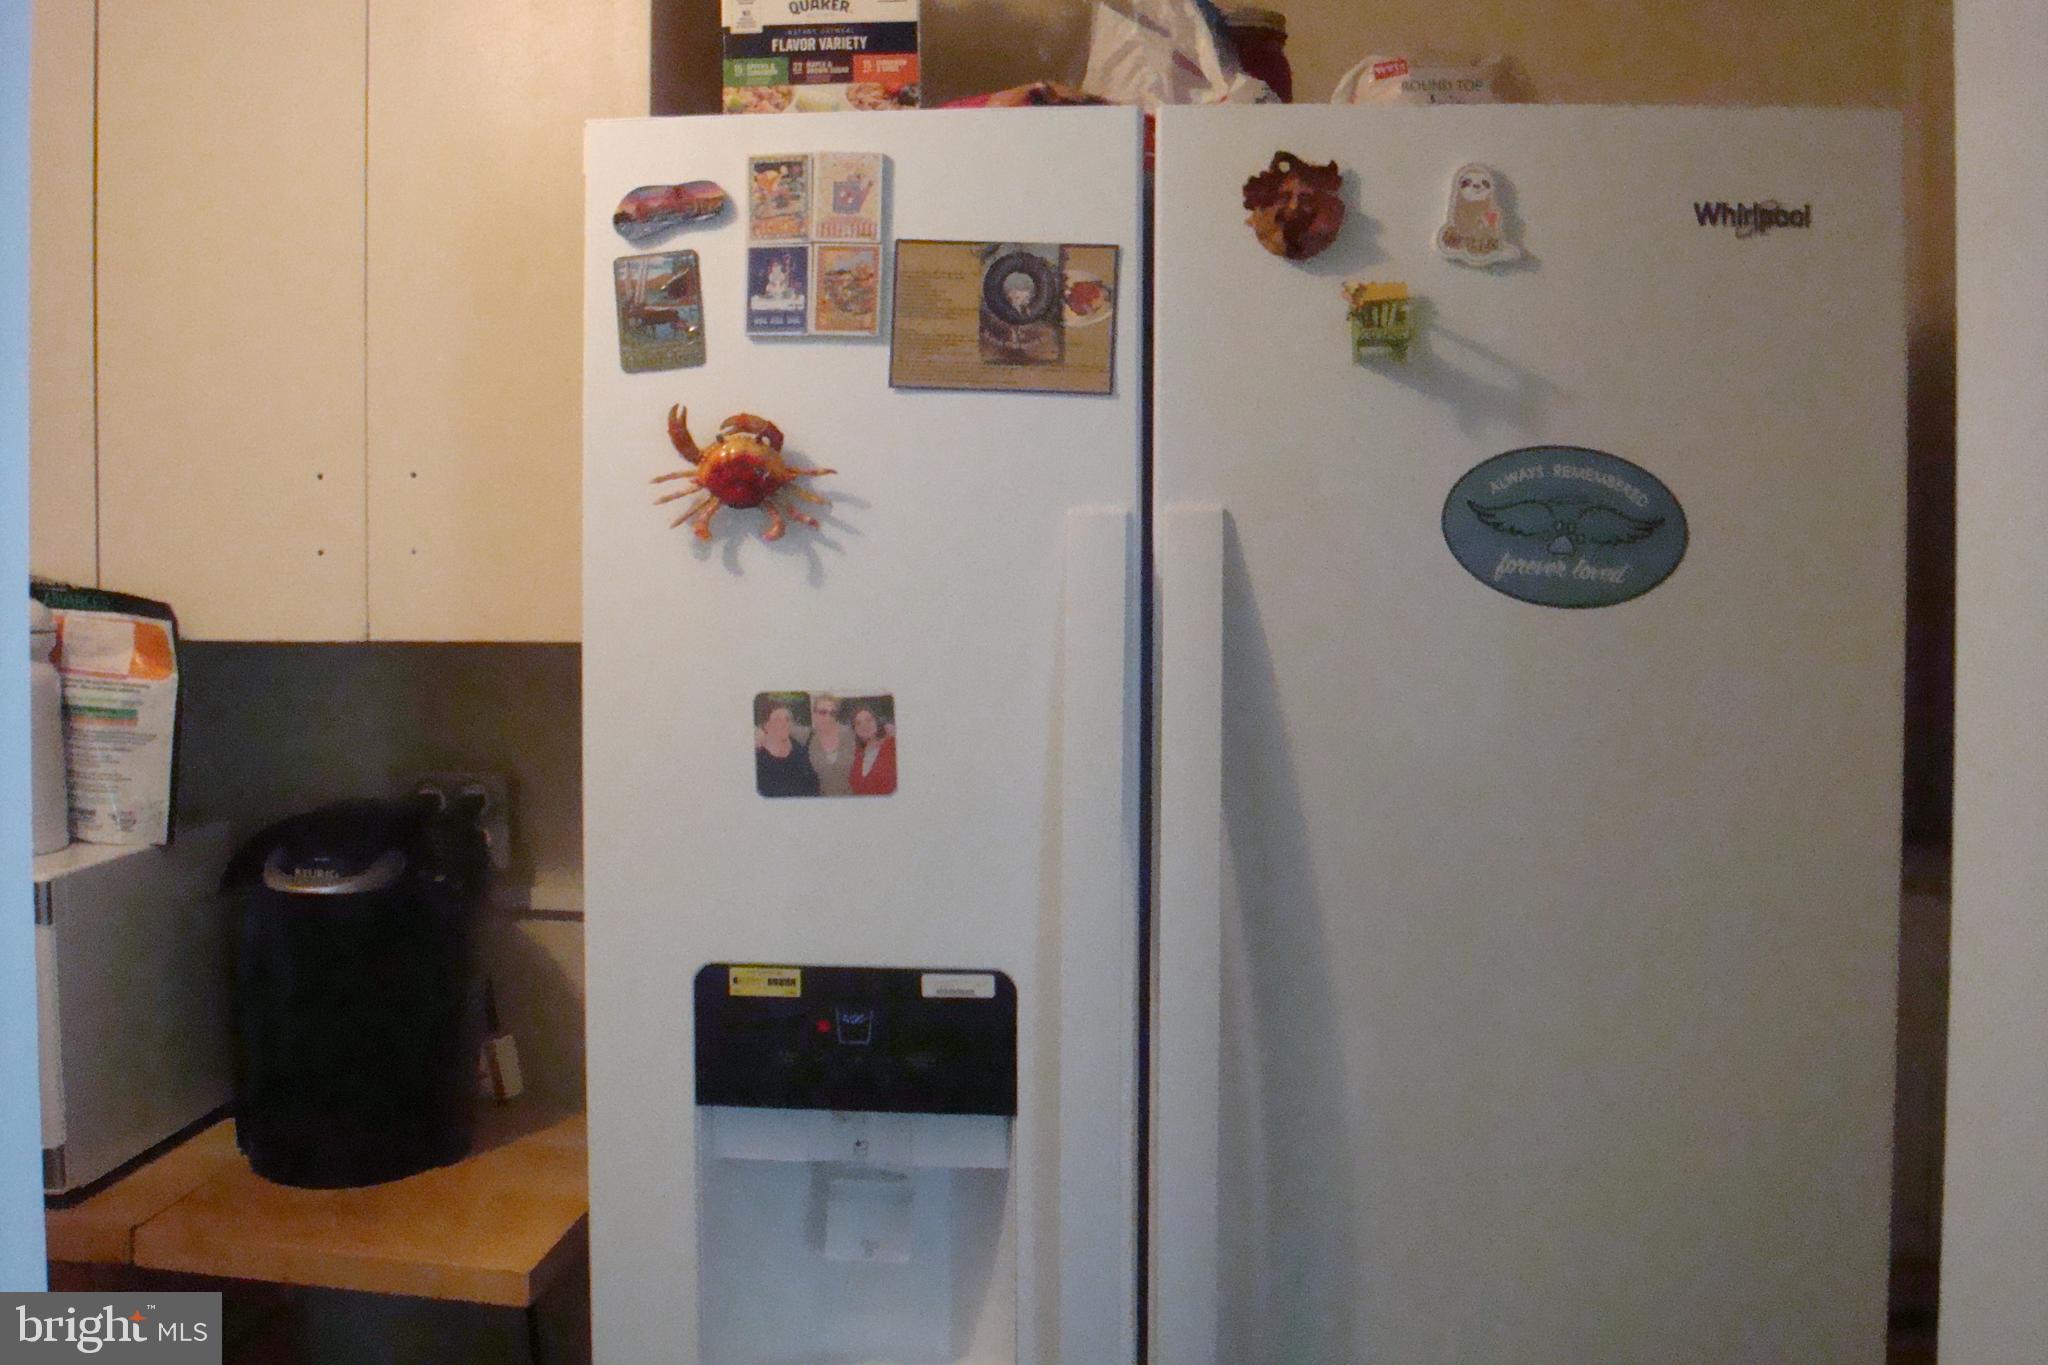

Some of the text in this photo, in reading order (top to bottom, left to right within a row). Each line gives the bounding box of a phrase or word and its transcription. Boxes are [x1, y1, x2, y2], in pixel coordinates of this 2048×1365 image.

[789, 0, 850, 14] QUAKER
[771, 36, 868, 52] FLAVOR VARIETY
[1456, 79, 1483, 92] TOP
[1488, 463, 1544, 495] ALWAYS
